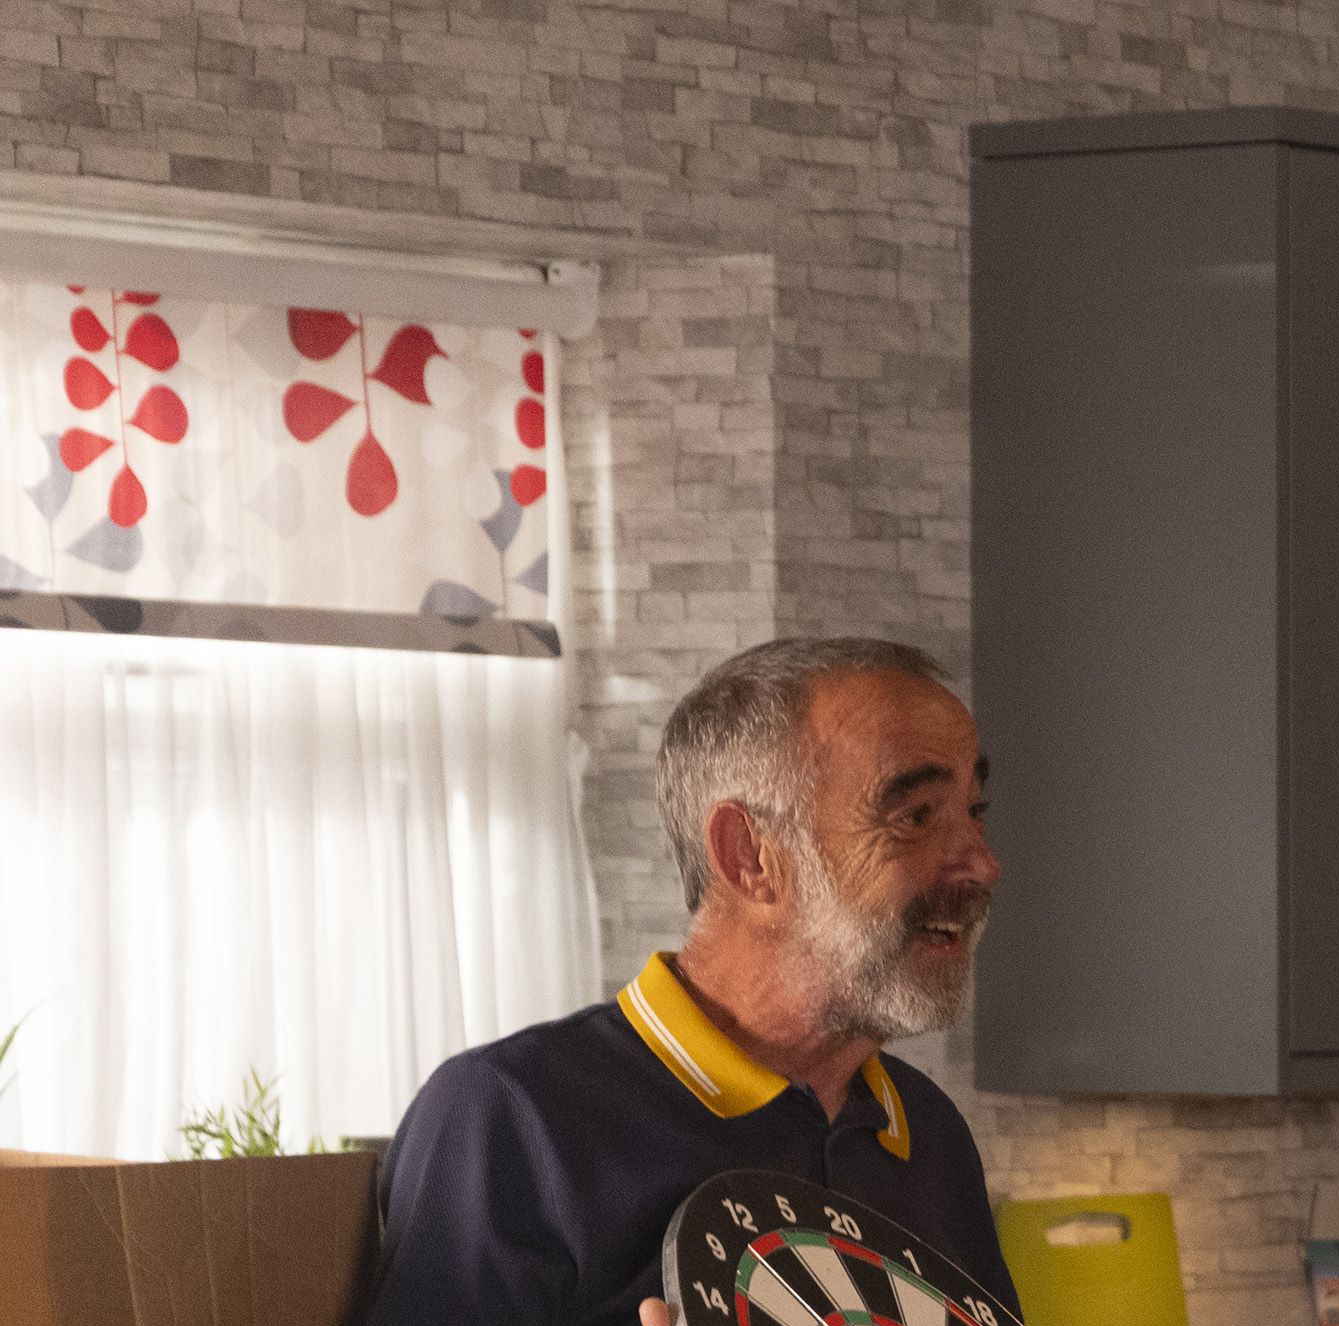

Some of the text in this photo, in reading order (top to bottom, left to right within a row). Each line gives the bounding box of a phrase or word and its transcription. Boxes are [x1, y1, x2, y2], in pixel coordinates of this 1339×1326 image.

[721, 1197, 759, 1233] 12
[774, 1193, 797, 1224] 5
[823, 1206, 862, 1241] 20
[705, 1232, 727, 1261] 9
[902, 1248, 922, 1276] 1
[692, 1280, 729, 1316] 14
